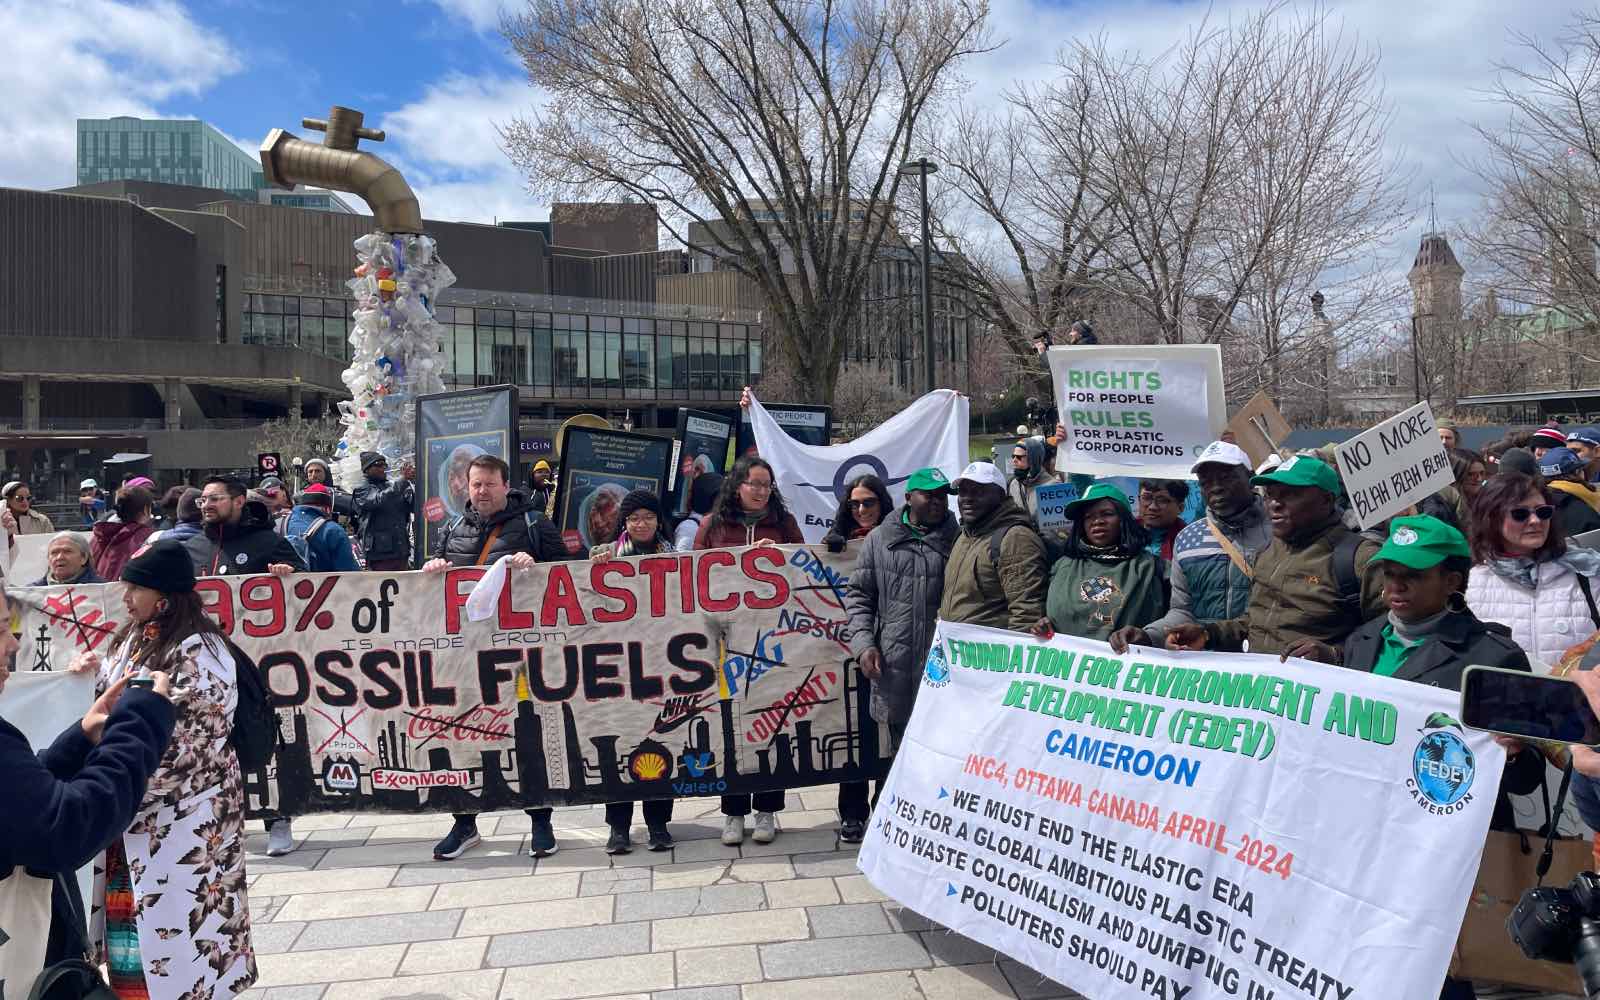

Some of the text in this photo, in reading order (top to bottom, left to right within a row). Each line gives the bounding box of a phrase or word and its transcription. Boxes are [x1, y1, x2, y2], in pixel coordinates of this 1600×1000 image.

[1068, 369, 1162, 391] RIGHTS
[1069, 392, 1155, 405] FOR PEOPLE
[1071, 410, 1154, 428] RULES
[1074, 429, 1165, 442] FOR PLASTIC
[1342, 410, 1432, 475] NO MORE
[520, 440, 551, 451] ELGIN
[1076, 440, 1184, 457] CORPORATIONS
[1353, 450, 1448, 520] BLAH BLAH BLAH
[804, 514, 836, 529] EAR
[1043, 505, 1064, 516] WO
[351, 578, 400, 634] of
[341, 638, 373, 651] IS
[724, 630, 785, 696] P&G
[258, 632, 717, 710] OSSIL FUELS
[947, 638, 1398, 746] FOUNDATION FOR ENVIRONMENT AND
[1002, 680, 1275, 761] DEVELOPMENT (FEDEV)
[373, 770, 468, 788] ExxonMobil
[1045, 728, 1201, 787] CAMEROON
[1420, 758, 1474, 784] FEDEV
[672, 780, 728, 794] Valero
[1406, 778, 1474, 816] CAMEROON
[964, 754, 1294, 880] INC4, OTTAWA CANADA APRIL 2024
[953, 789, 1254, 918] WE MUST END THE PLASTIC ERA
[895, 827, 910, 849] TO
[911, 835, 969, 871] WASTE
[971, 858, 1095, 926] COLONIALISM
[1096, 911, 1135, 943] AND
[1136, 926, 1241, 995] DUMPING
[1245, 980, 1276, 1000] IN
[896, 797, 1355, 1000] YES, FOR A GLOBAL AMBITIOUS PLASTIC TREATY
[960, 885, 1193, 1000] POLLUTERS SHOULD PAY
